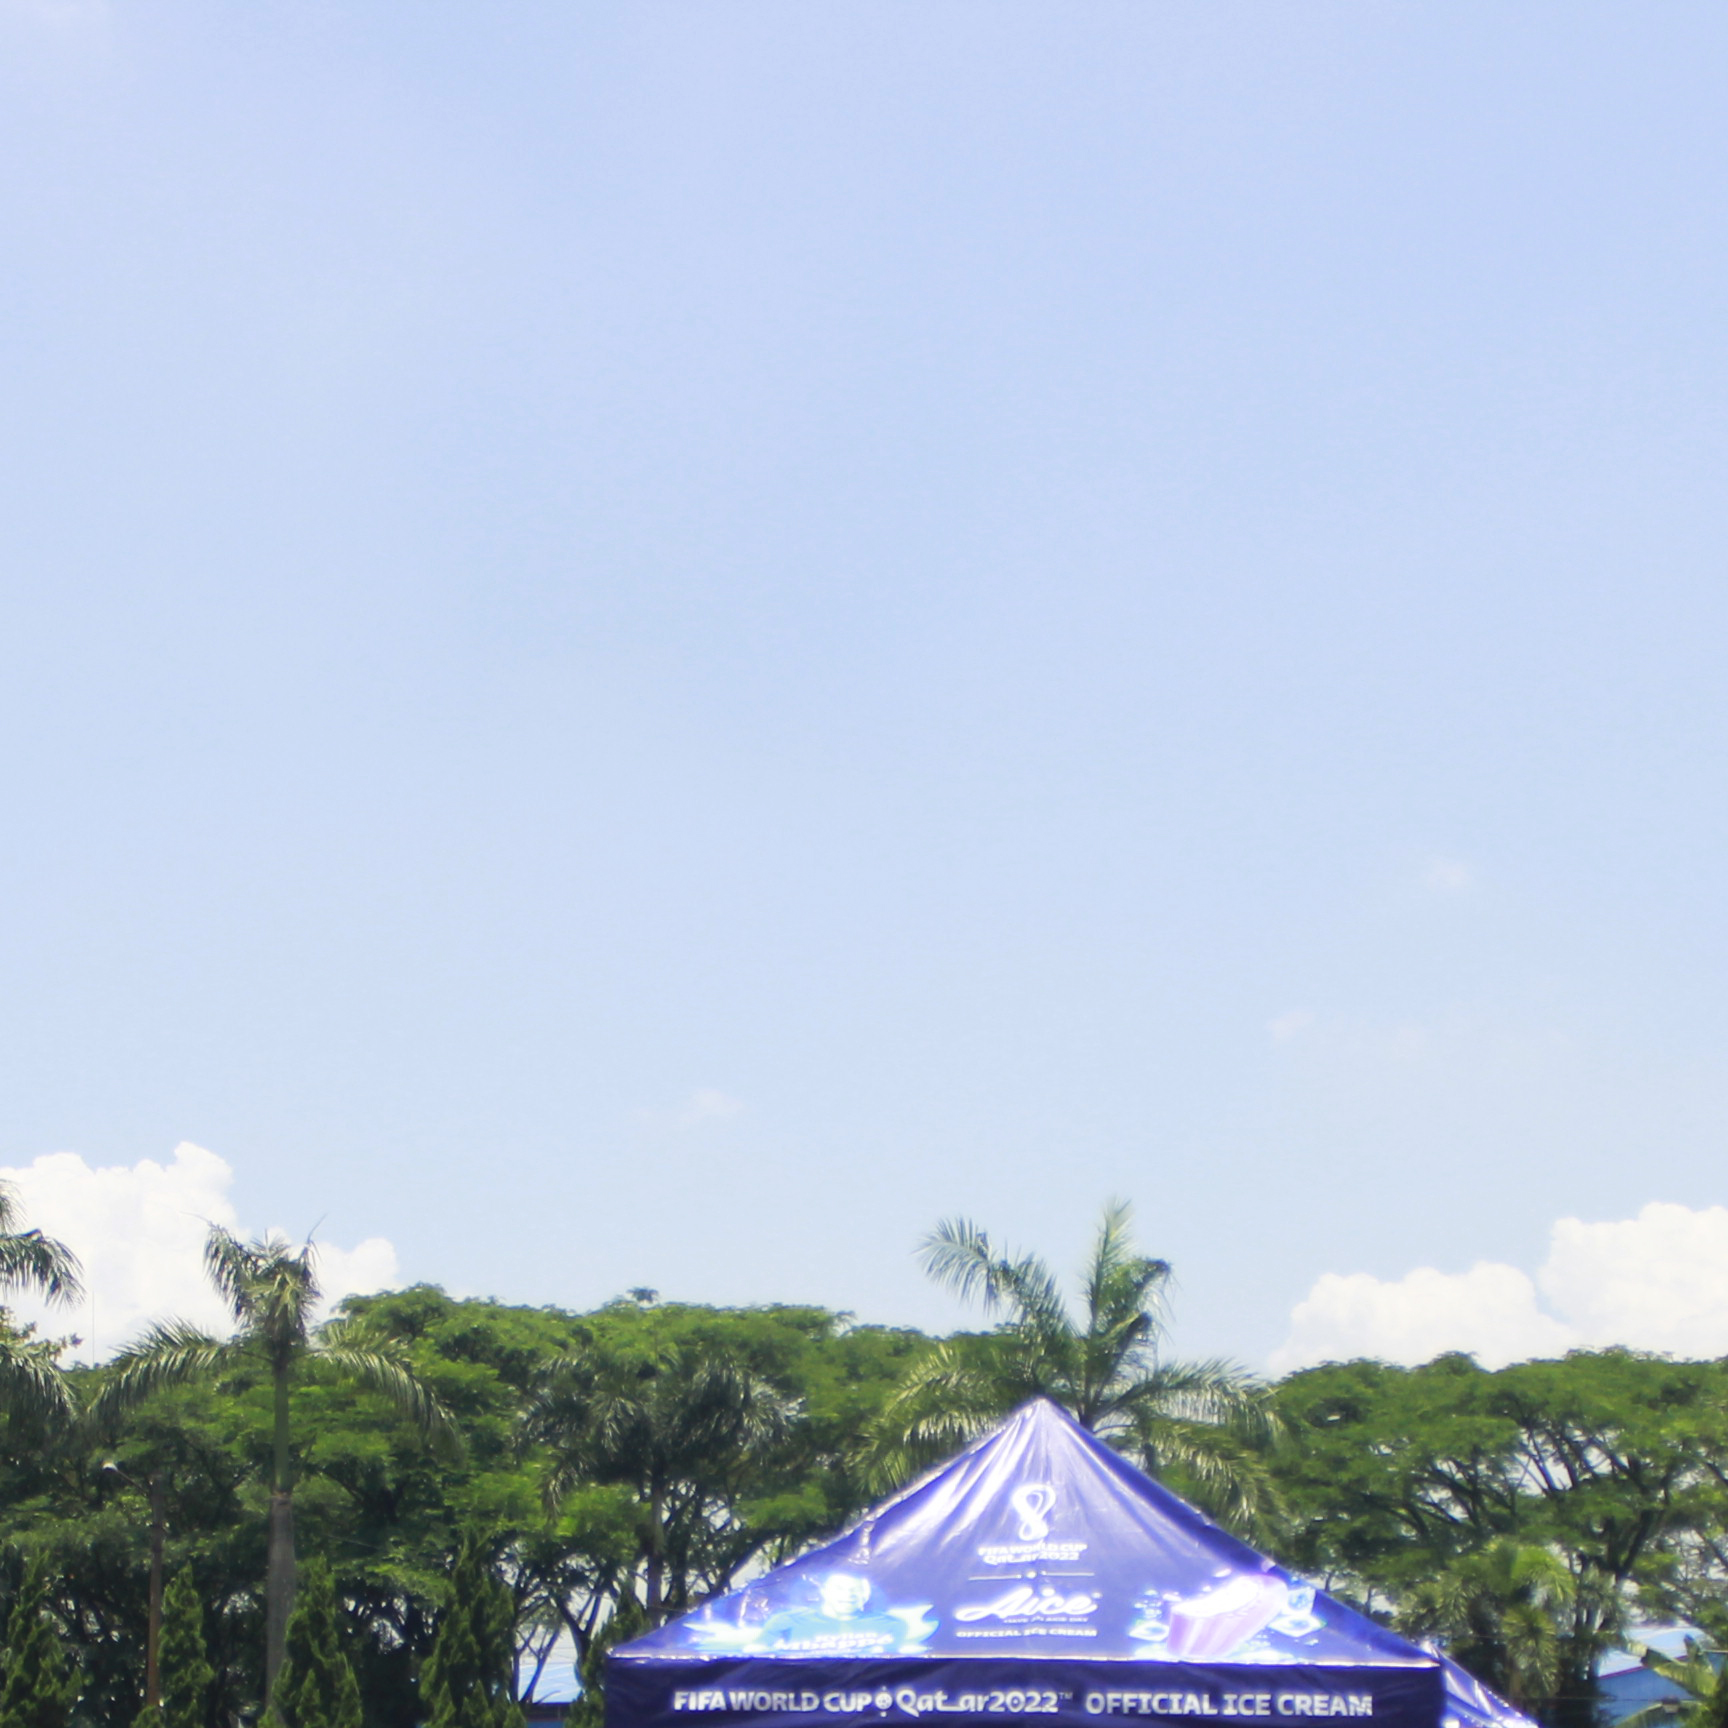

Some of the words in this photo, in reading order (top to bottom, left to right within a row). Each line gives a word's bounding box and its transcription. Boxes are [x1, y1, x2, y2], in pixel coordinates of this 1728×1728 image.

[1049, 1628, 1098, 1637] CREAM
[673, 1691, 726, 1711] FIFA
[728, 1691, 820, 1712] WORLD
[823, 1692, 872, 1712] CUP
[896, 1689, 1059, 1718] Qatar2022
[1085, 1692, 1218, 1715] OFFICIAL
[1223, 1694, 1271, 1716] ICE
[1277, 1694, 1372, 1716] CREAM
